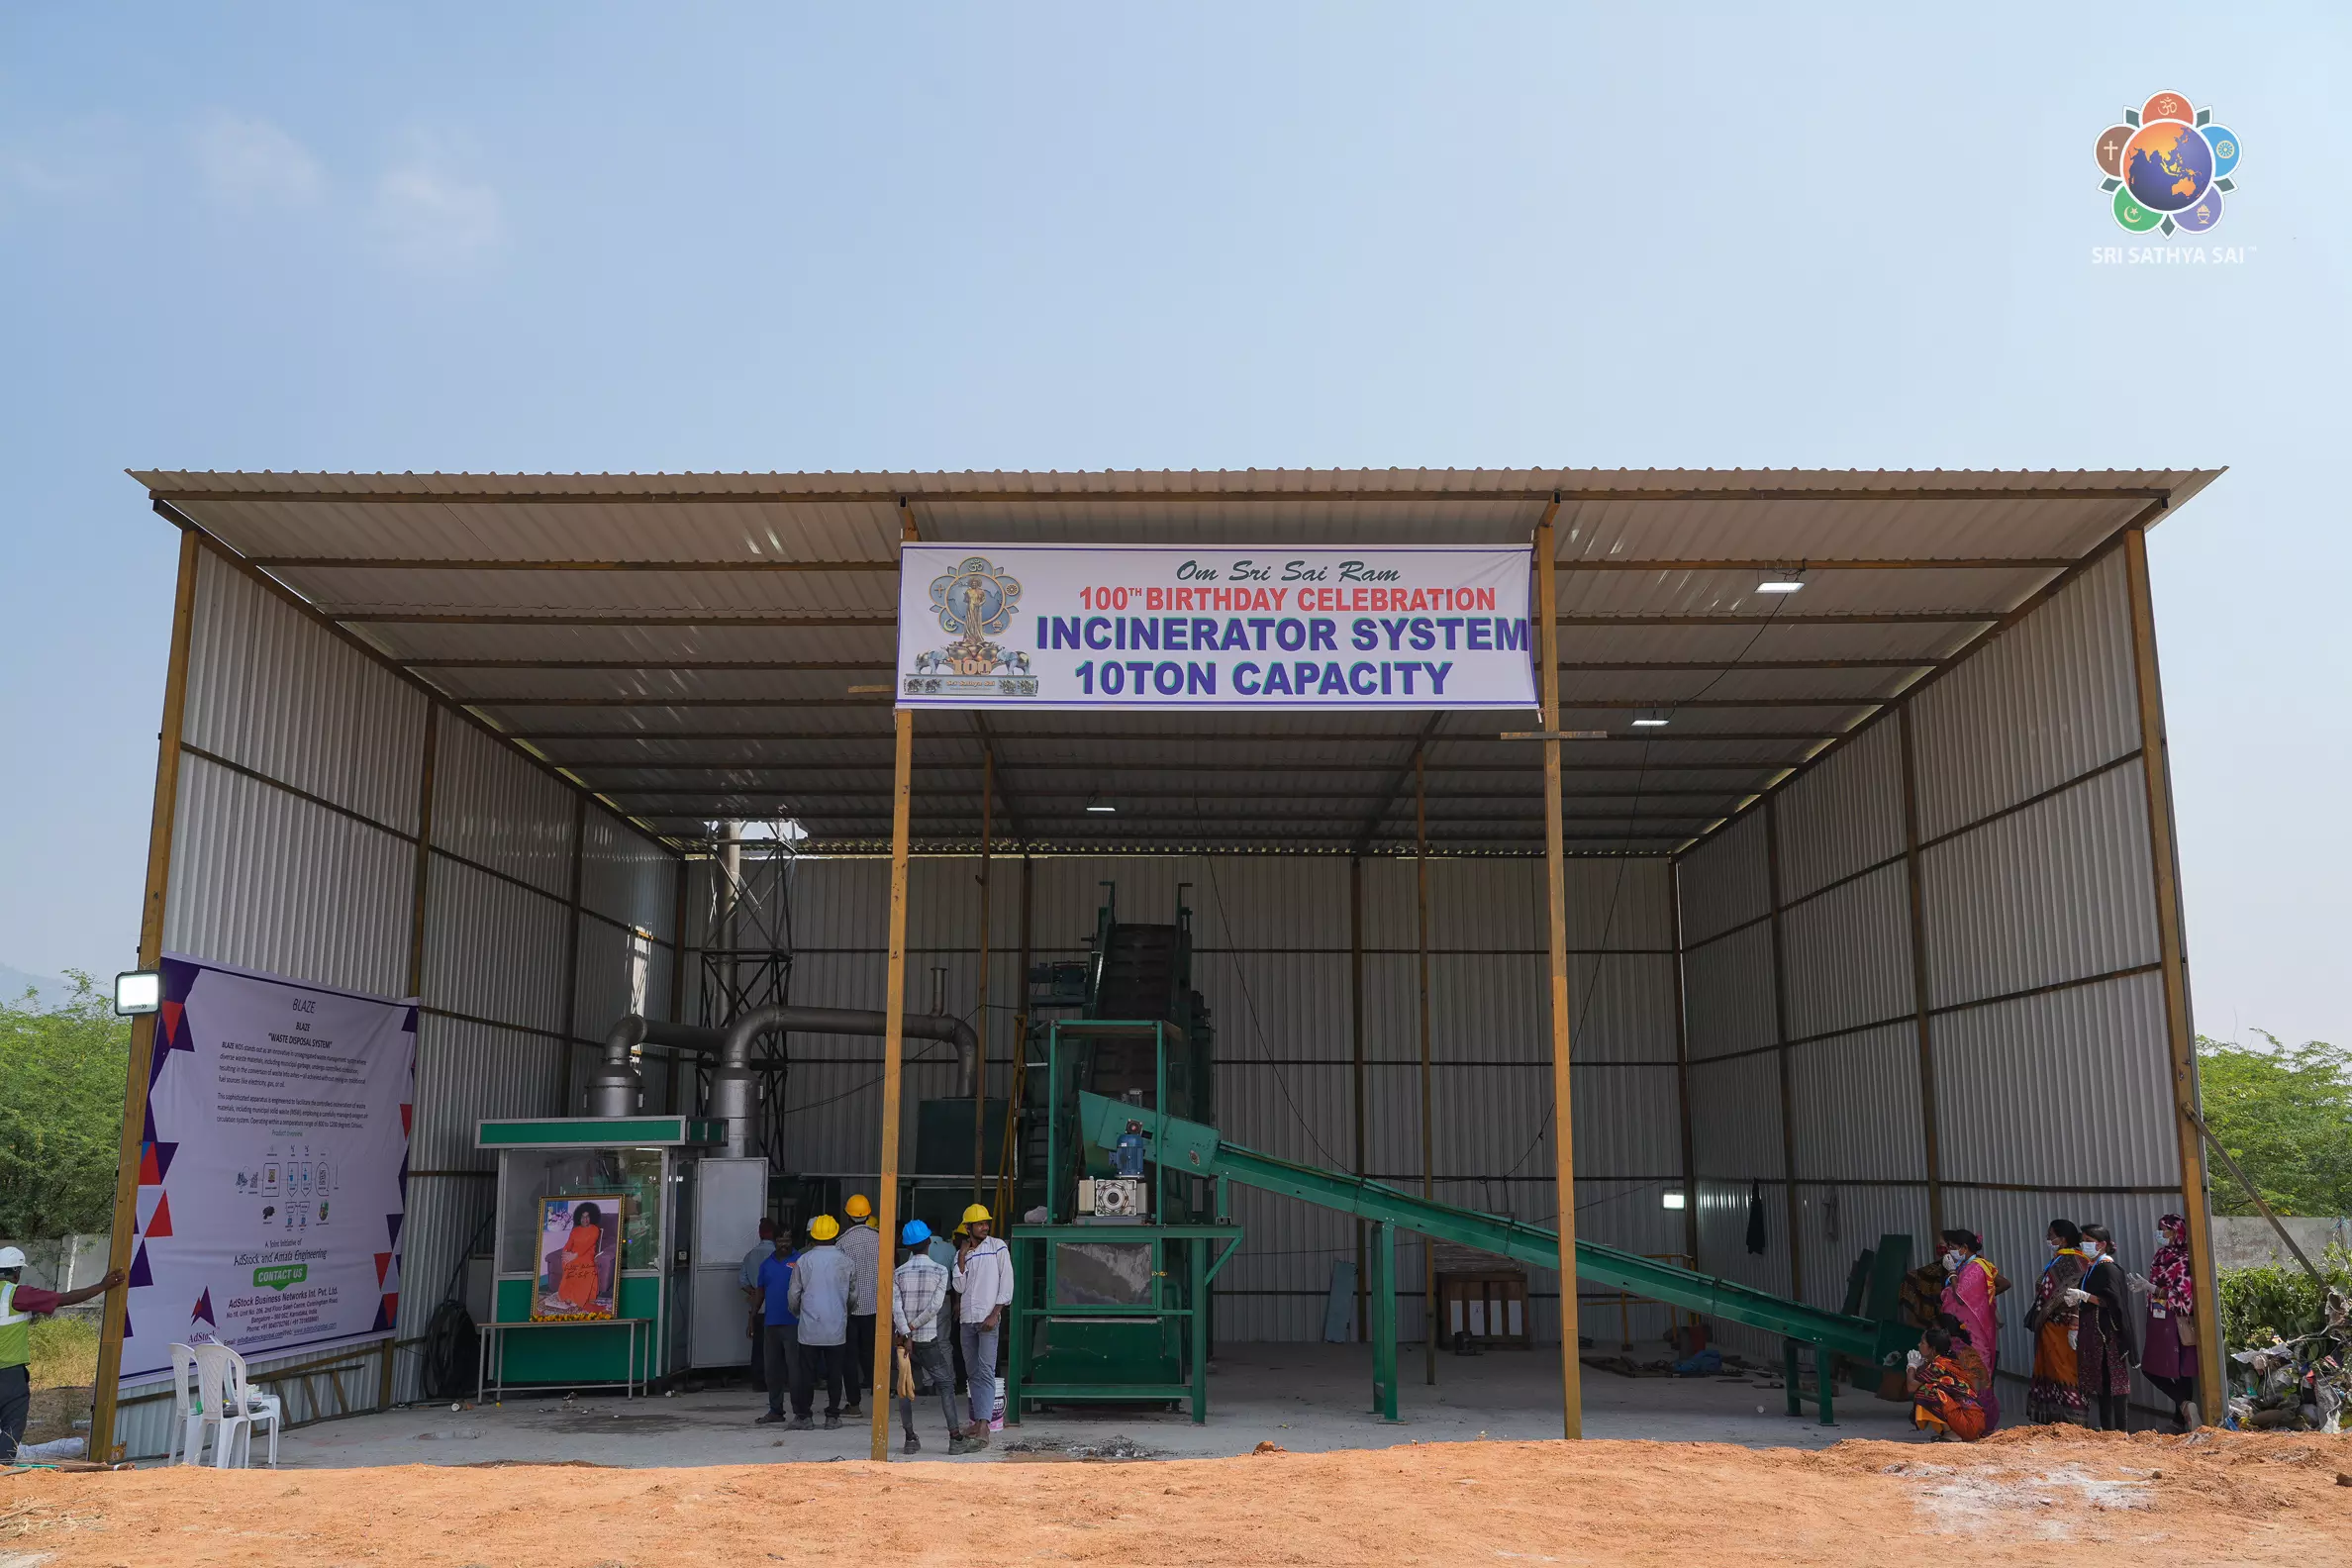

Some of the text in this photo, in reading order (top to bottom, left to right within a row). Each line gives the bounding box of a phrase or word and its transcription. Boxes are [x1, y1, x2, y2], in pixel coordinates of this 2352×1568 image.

[1176, 559, 1401, 582] Om Sri Sai Ram
[1145, 587, 1289, 611] BIRTHDAY
[1297, 587, 1496, 612] CELEBRATION
[1036, 616, 1528, 652] INCINERATOR SYSTEM
[954, 659, 992, 676] 100
[1075, 660, 1453, 696] 10TON CAPACITY
[292, 998, 317, 1014] BLAZE
[295, 1022, 311, 1031] BLAZE
[289, 1035, 312, 1047] DISPOSAL
[234, 1253, 259, 1266] AdStock
[261, 1251, 273, 1264] and
[294, 1248, 328, 1262] Engineering
[257, 1267, 303, 1283] CONTACT US
[229, 1297, 254, 1310] AdStock
[254, 1294, 281, 1306] Business
[282, 1290, 308, 1302] Networks
